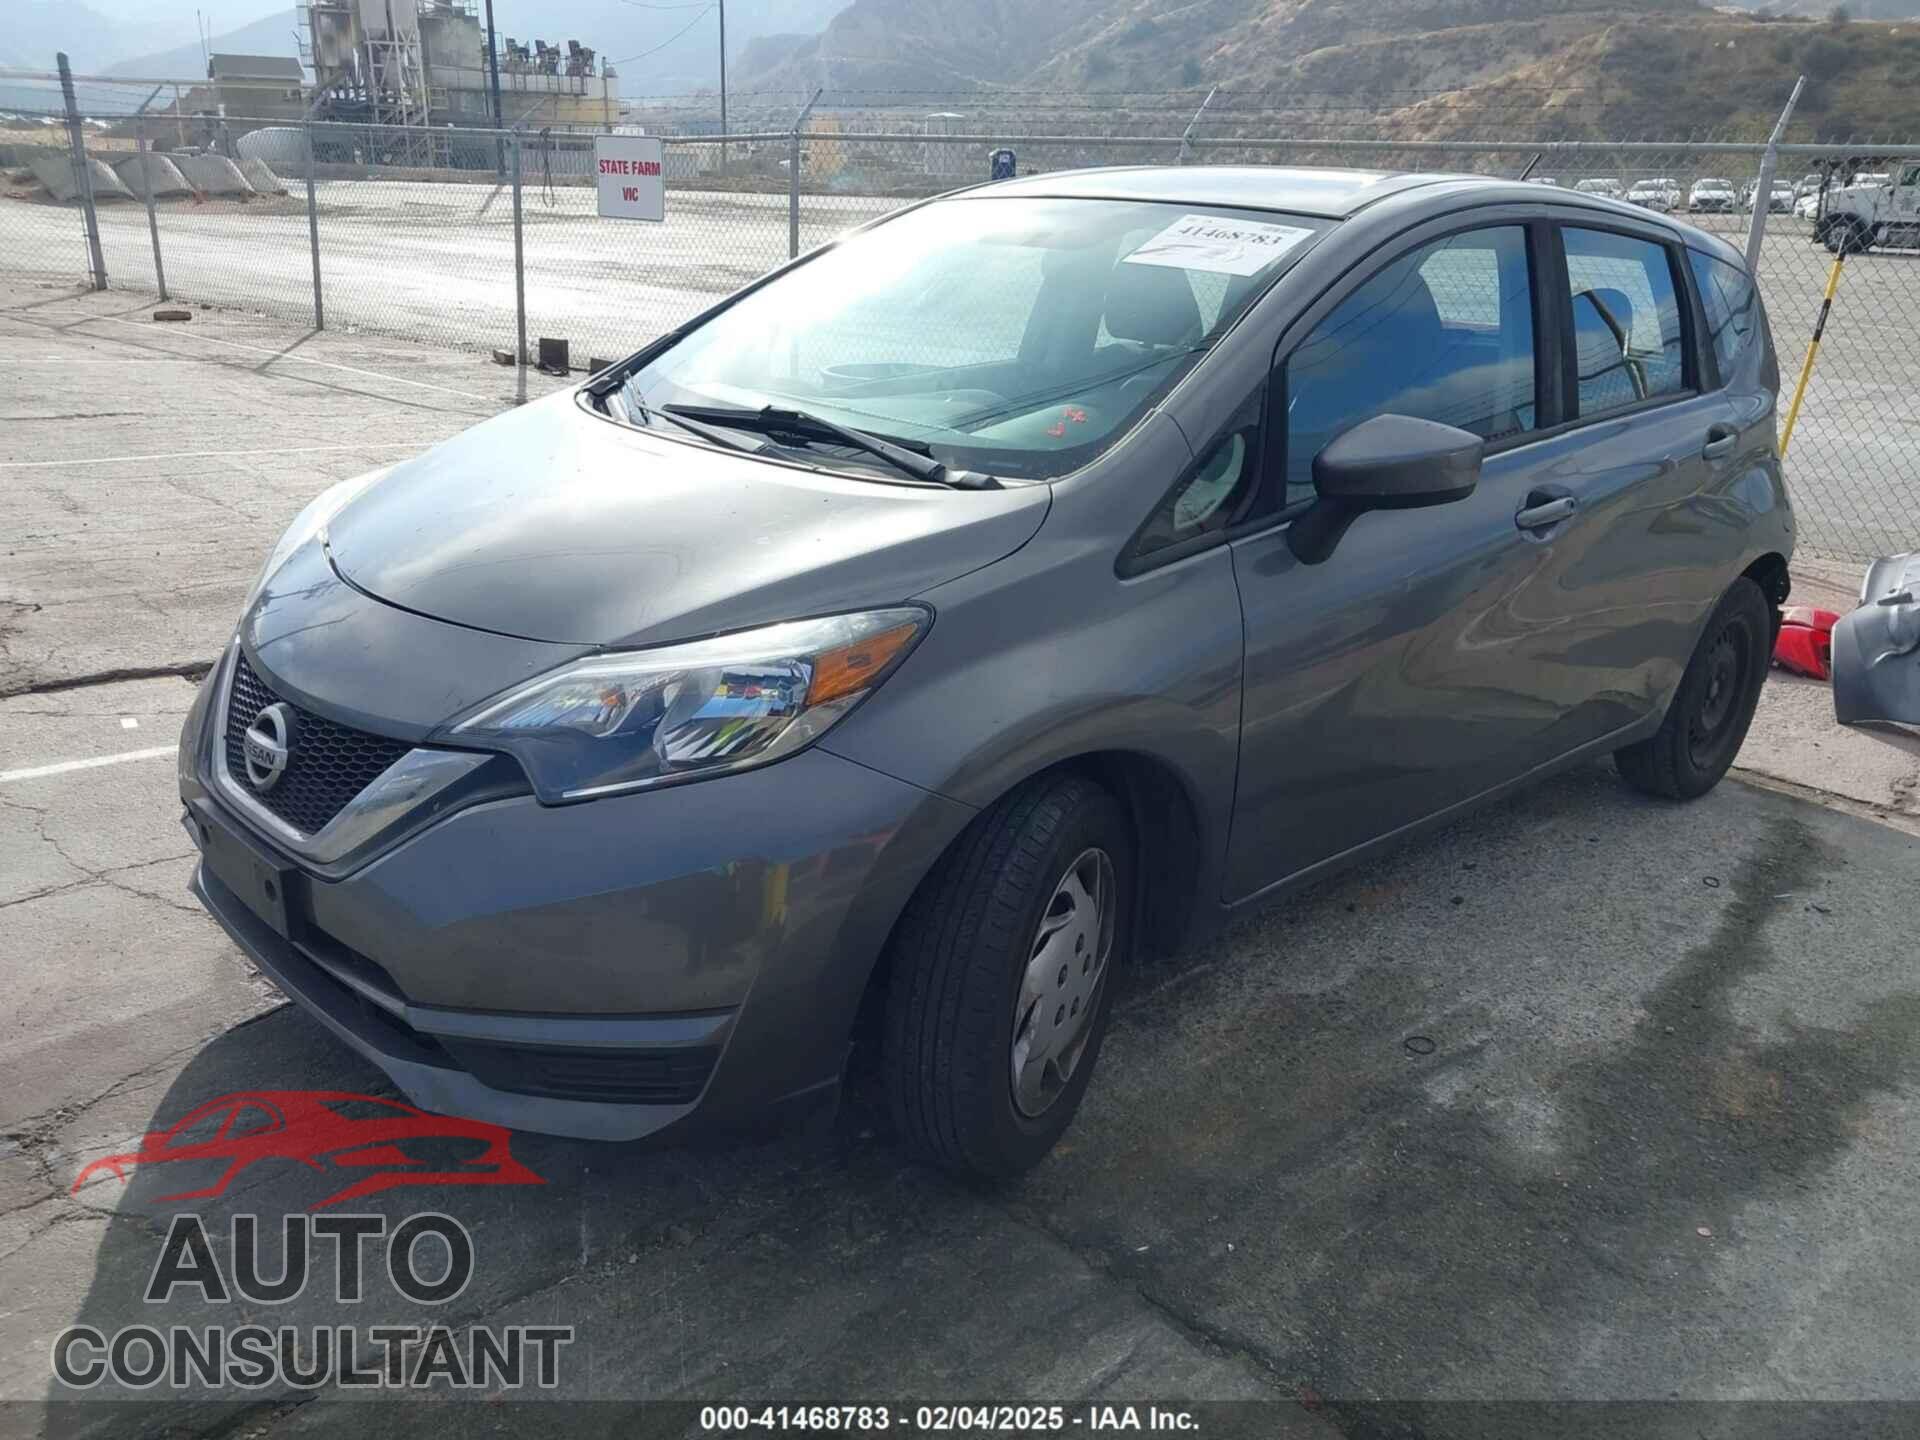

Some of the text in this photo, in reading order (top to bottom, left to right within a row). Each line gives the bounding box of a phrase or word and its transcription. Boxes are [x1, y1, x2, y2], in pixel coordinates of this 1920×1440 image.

[599, 160, 661, 177] STATE FARM
[622, 187, 639, 202] VIC
